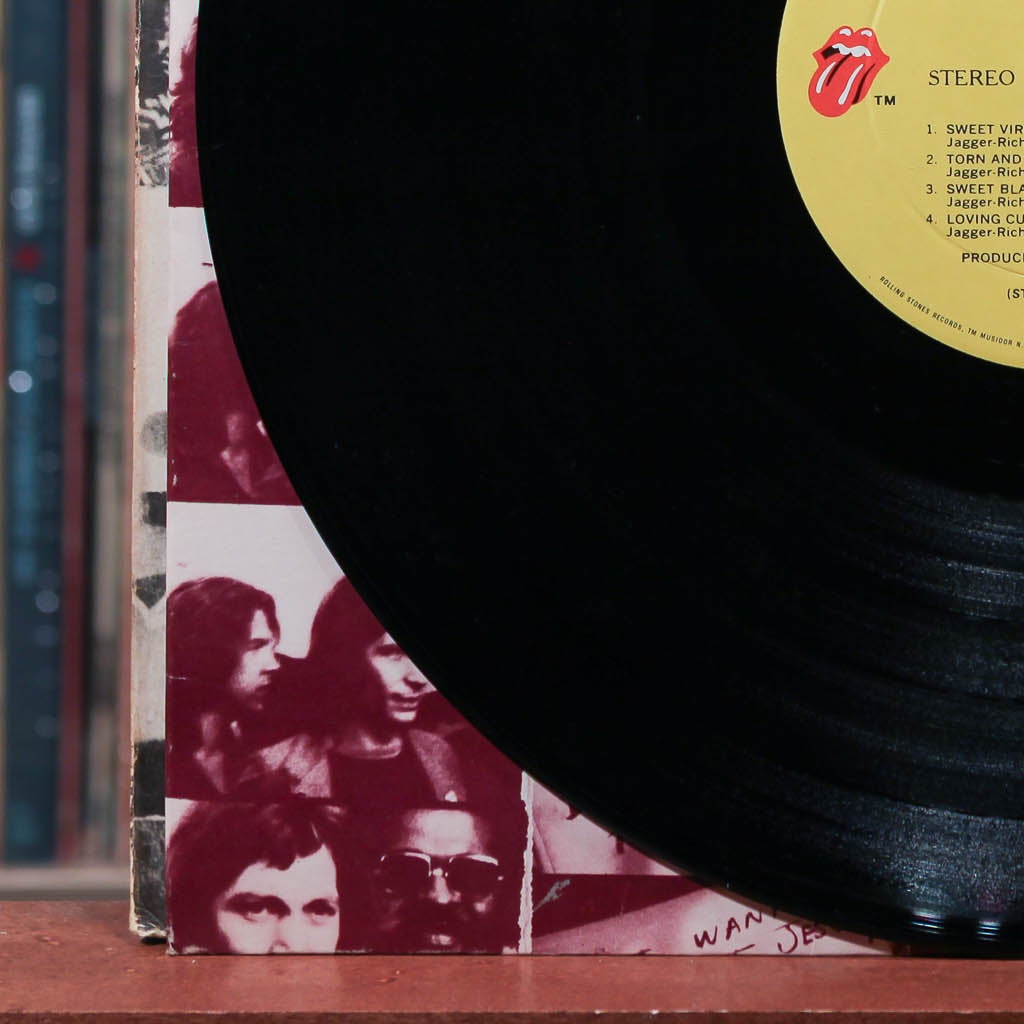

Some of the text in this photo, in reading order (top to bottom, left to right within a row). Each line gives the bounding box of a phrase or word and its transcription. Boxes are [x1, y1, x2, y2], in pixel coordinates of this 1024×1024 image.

[928, 69, 1016, 87] STEREO
[873, 95, 897, 106] TM
[926, 124, 937, 135] 1.
[946, 124, 995, 135] SWEET
[926, 154, 937, 165] 2.
[946, 154, 986, 165] TORN
[991, 154, 1022, 165] AND
[926, 184, 937, 195] 3.
[946, 184, 995, 195] SWEET
[926, 214, 937, 225] 4.
[946, 214, 1001, 225] LOVING
[880, 276, 905, 298] ROLLING
[907, 296, 930, 315] STONES
[932, 312, 964, 333] RECORDS,
[967, 327, 978, 336] TM
[980, 331, 1013, 346] MUSIDOR
[694, 908, 779, 948] WAN
